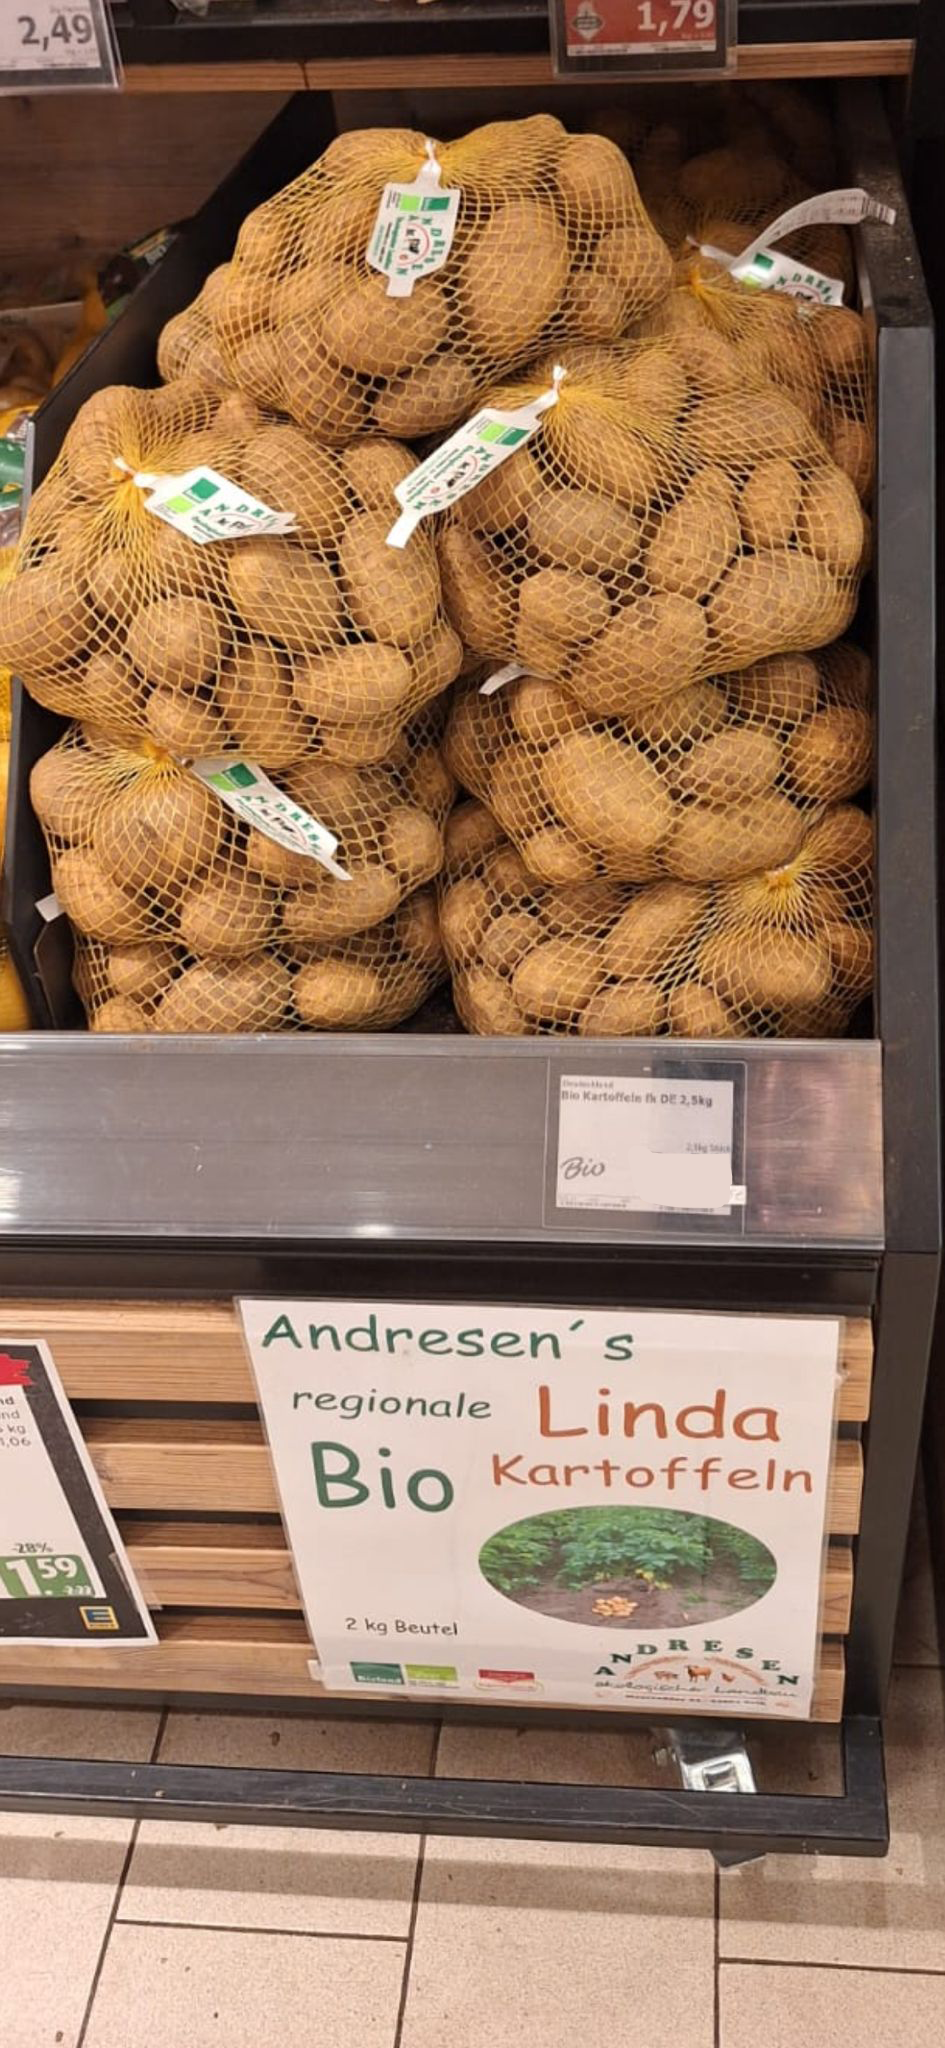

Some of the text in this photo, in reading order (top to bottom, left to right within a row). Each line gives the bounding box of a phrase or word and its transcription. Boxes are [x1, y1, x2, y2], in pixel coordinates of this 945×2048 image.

[18, 14, 92, 52] 2,49
[637, 0, 715, 37] 1,79
[561, 1090, 580, 1101] Bio
[583, 1090, 642, 1104] Kartoffeln
[660, 1094, 677, 1105] DE
[680, 1094, 713, 1108] 2,5kg
[560, 1156, 606, 1180] Bio
[292, 1385, 782, 1442] regionale Linda
[311, 1441, 813, 1513] Bio Kartoffeln
[345, 1617, 458, 1636] 2 kg Beutel
[595, 1639, 800, 1685] ANDRESEN
